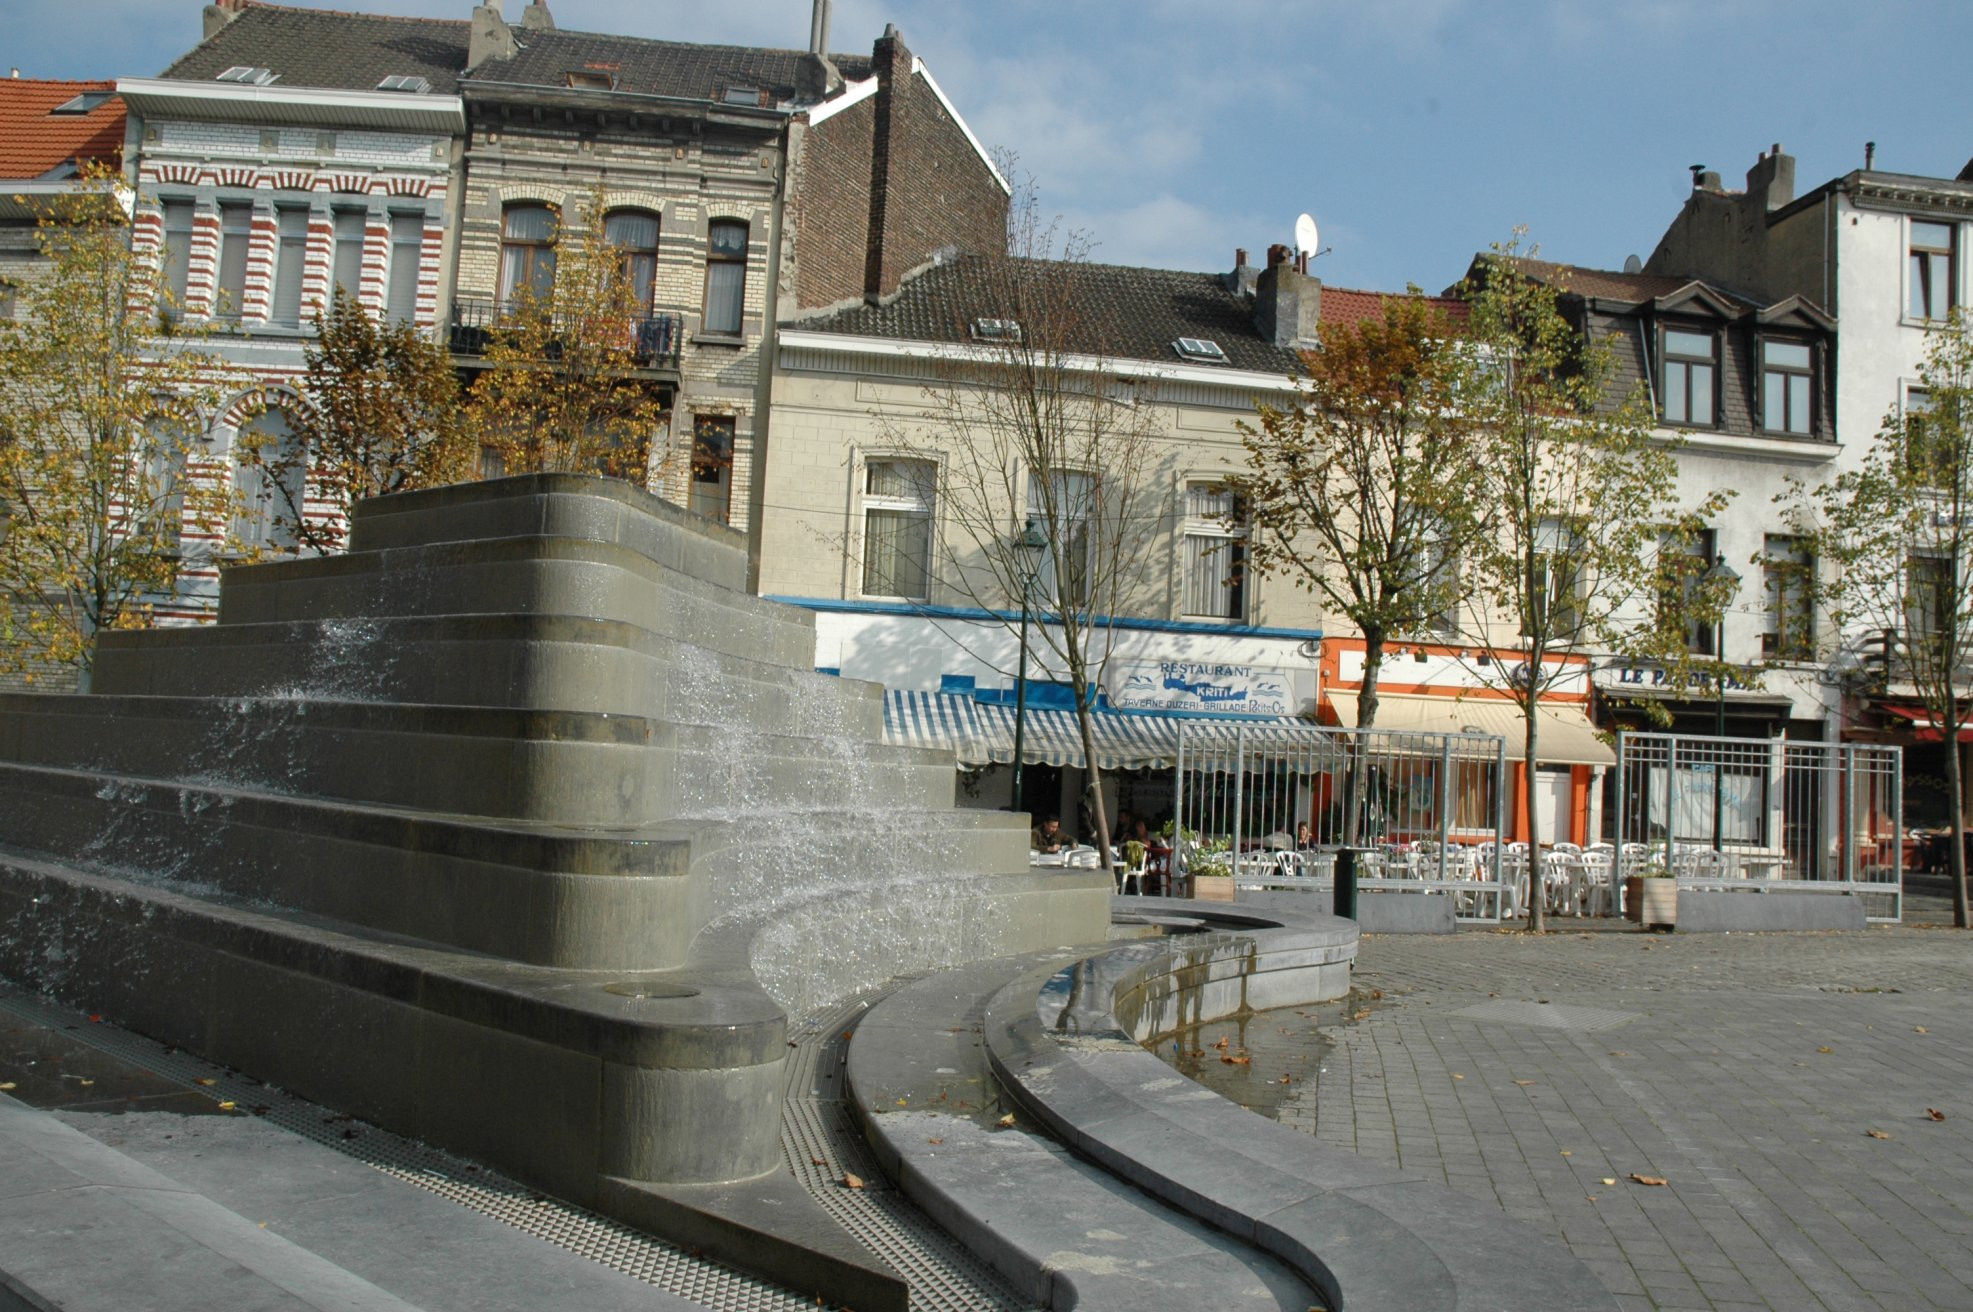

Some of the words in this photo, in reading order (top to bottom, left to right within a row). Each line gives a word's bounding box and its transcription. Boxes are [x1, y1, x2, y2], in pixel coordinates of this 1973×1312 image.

[1160, 662, 1252, 678] RESTAURANT
[1619, 667, 1644, 685] LE
[1196, 687, 1228, 698] KRITI
[1123, 697, 1164, 708] TAVERNE
